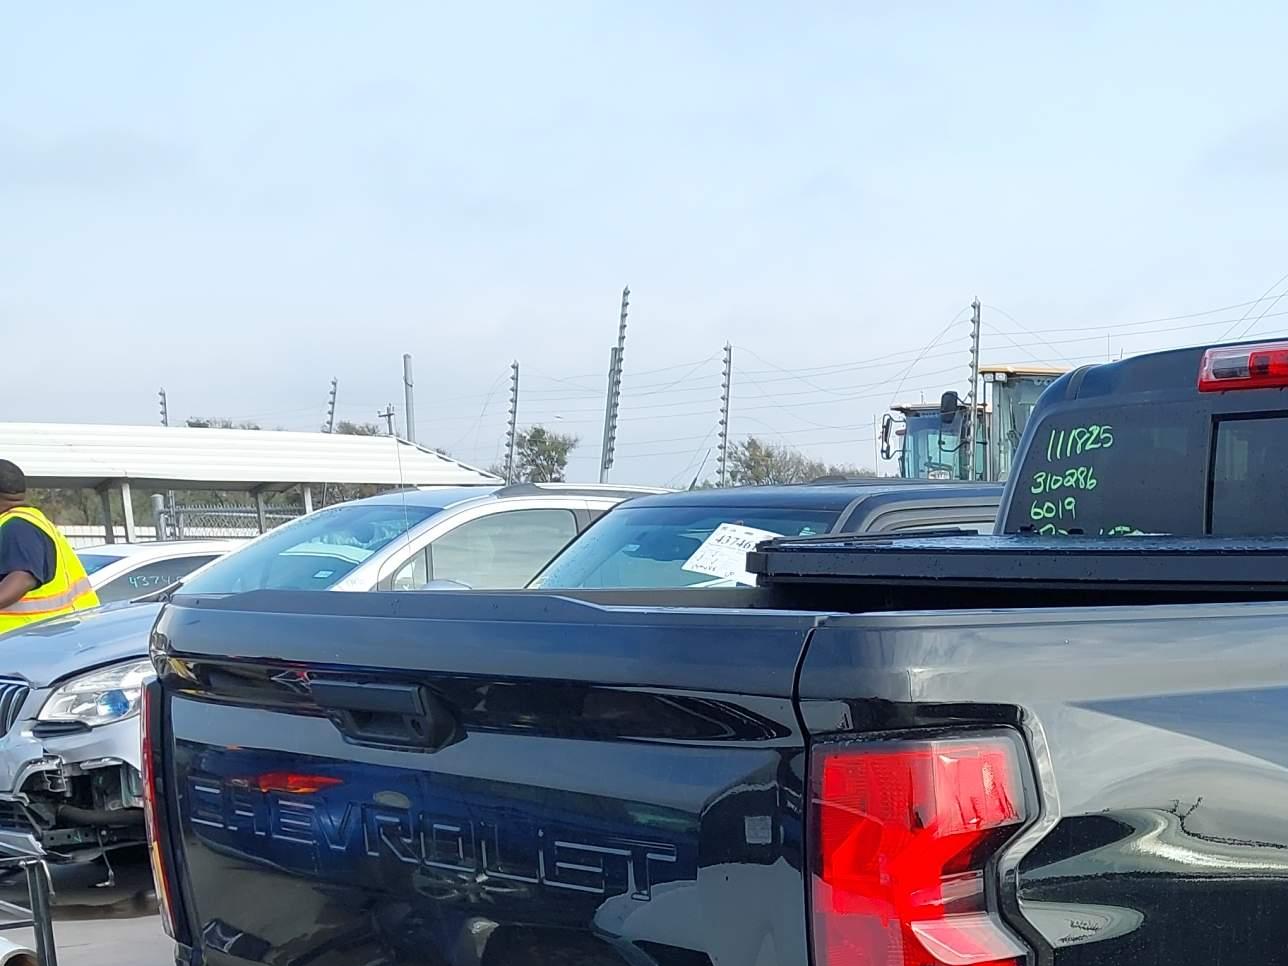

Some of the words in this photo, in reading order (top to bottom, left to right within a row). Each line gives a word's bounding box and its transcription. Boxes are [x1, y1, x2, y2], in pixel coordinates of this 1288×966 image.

[1047, 425, 1114, 462] 111825
[1031, 466, 1097, 494] 310286
[1030, 497, 1077, 520] 6019
[187, 775, 677, 901] CHEVROLET
